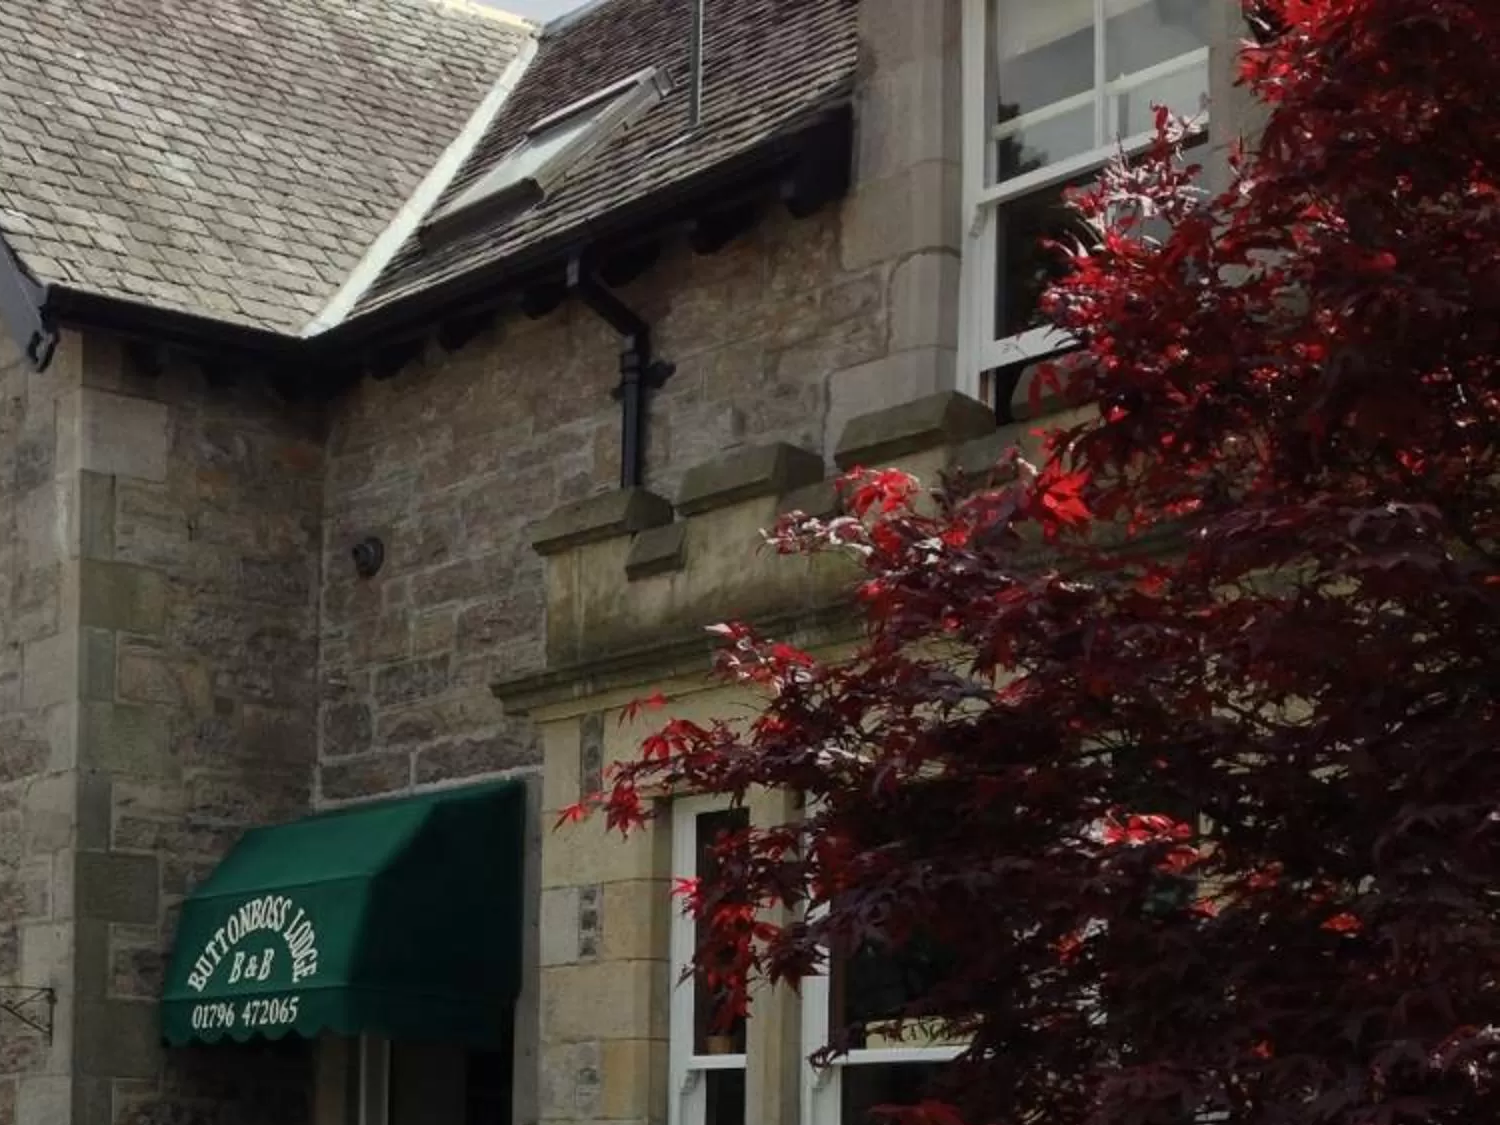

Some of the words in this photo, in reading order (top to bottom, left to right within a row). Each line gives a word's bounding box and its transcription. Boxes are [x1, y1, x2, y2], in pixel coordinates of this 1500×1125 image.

[187, 895, 293, 992] BUTTONBOSS
[283, 907, 319, 983] LODGE
[191, 1002, 235, 1029] 01796
[241, 996, 300, 1027] 472065
